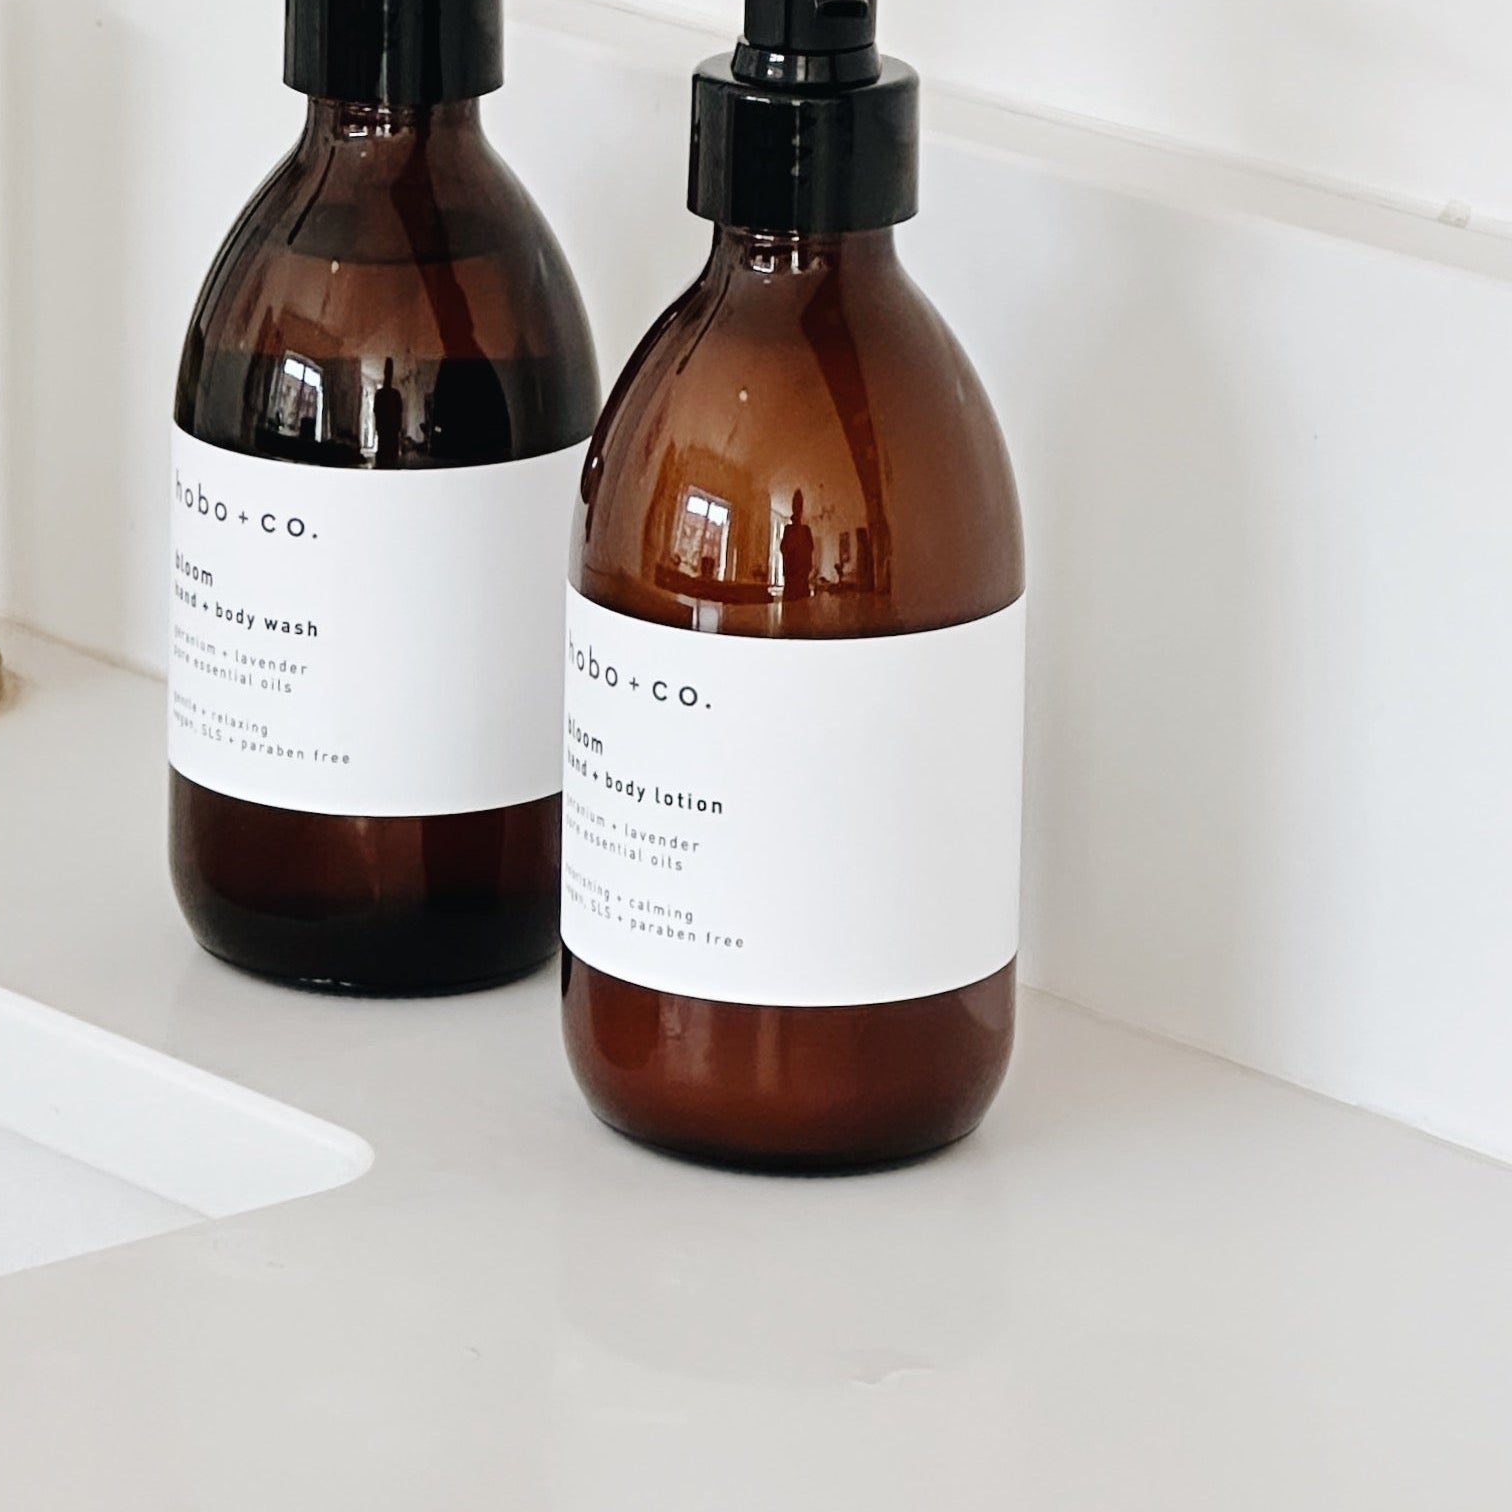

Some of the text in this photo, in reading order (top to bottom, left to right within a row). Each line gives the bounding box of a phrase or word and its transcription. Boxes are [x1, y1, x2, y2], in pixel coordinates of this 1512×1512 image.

[175, 467, 228, 522] hobo
[175, 548, 213, 588] bloom
[175, 579, 197, 608] hand
[215, 601, 254, 630] body
[264, 615, 318, 637] wash
[193, 657, 253, 687] essential
[261, 677, 293, 693] oils
[235, 649, 308, 675] lavender
[568, 628, 619, 688] hobo
[201, 723, 222, 742] SLS
[241, 738, 304, 760] paraben
[314, 748, 351, 765] free
[211, 711, 269, 738] relaxing
[567, 712, 603, 757] bloom
[605, 771, 645, 804] body
[655, 786, 724, 816] lotion
[584, 829, 643, 863] essential
[651, 853, 683, 872] oils
[625, 823, 701, 853] lavender
[591, 899, 611, 920] SLS
[630, 916, 697, 943] paraben
[706, 931, 744, 949] free
[629, 896, 694, 925] calming
